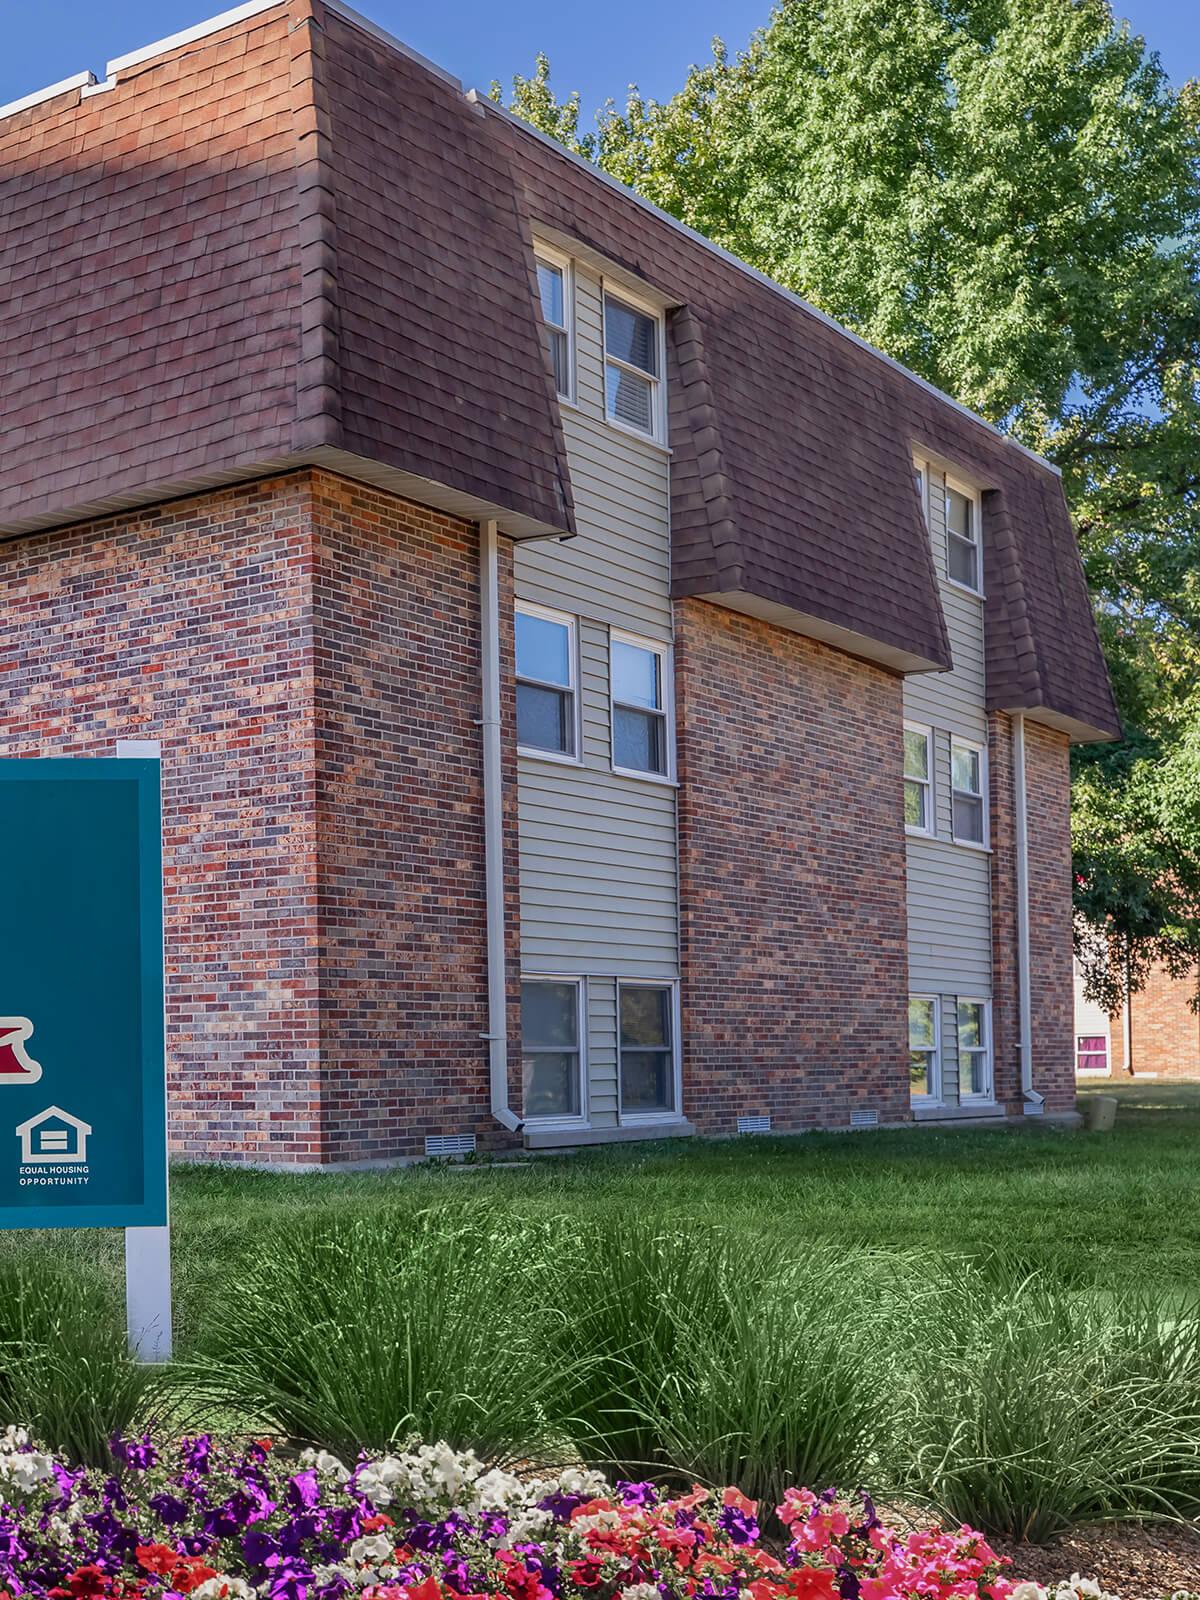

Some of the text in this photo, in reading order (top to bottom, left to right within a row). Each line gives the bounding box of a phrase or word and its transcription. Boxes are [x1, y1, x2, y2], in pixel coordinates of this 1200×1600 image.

[19, 1166, 89, 1175] EQUAL HOUSING
[19, 1177, 89, 1186] OPPORTUNITY
